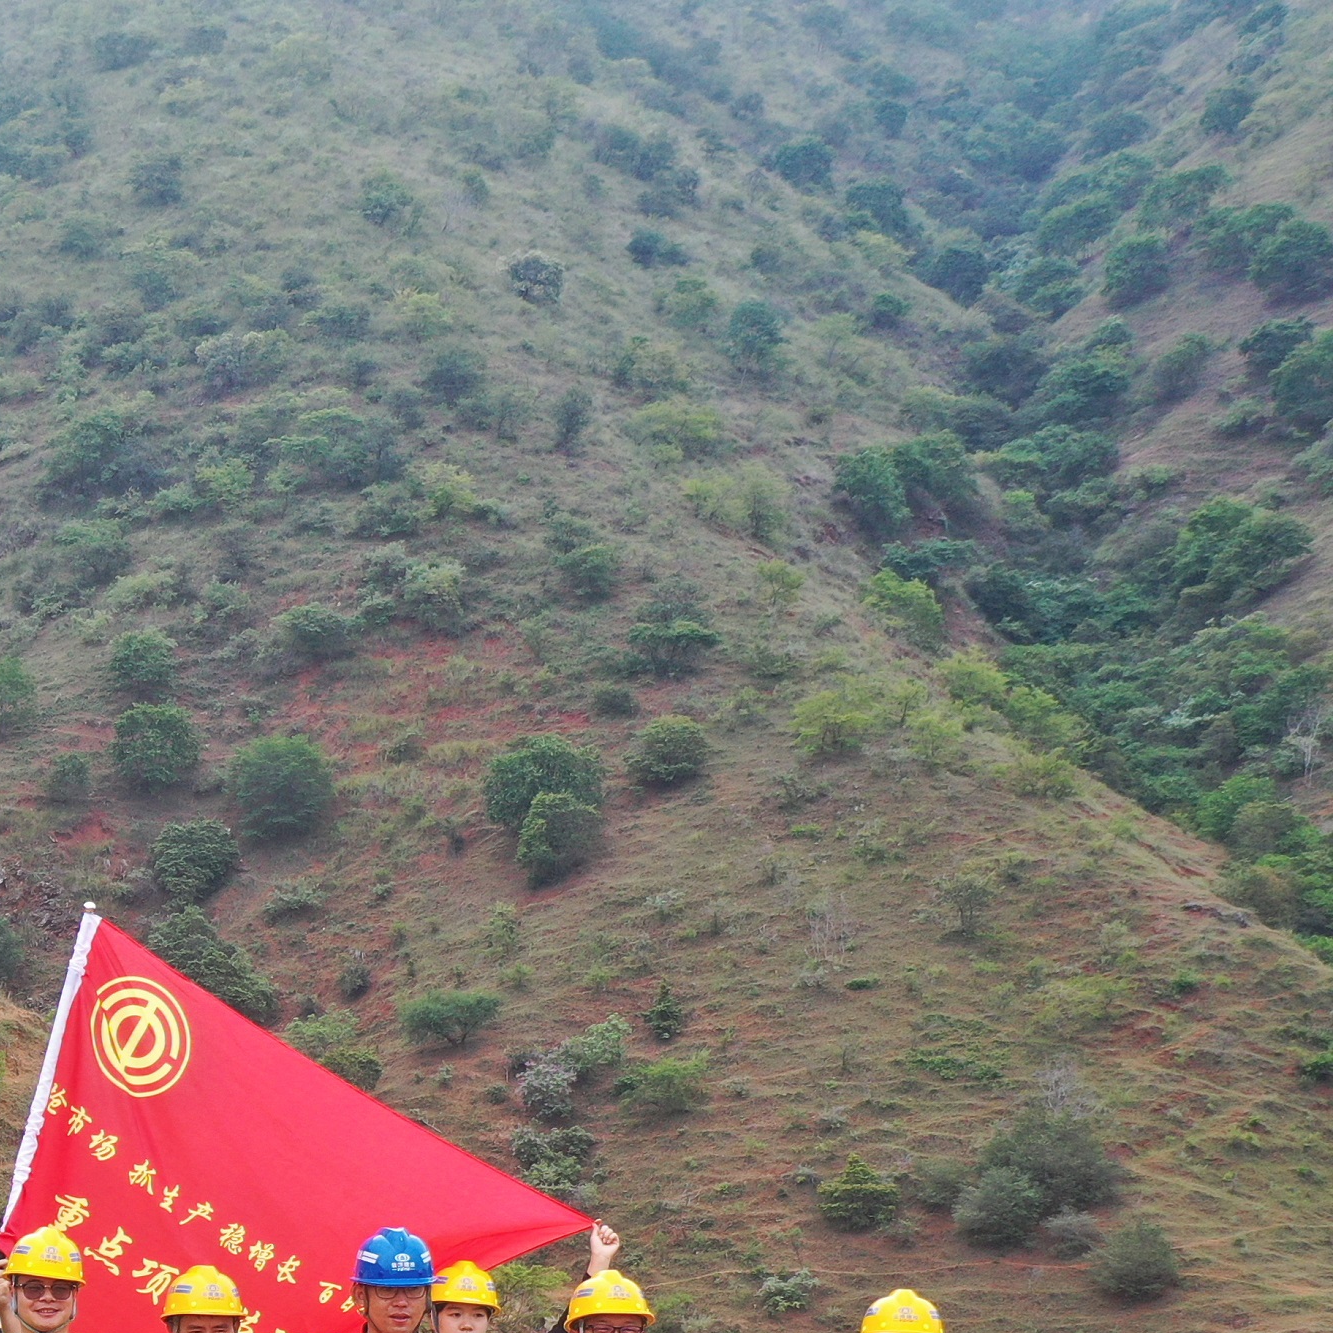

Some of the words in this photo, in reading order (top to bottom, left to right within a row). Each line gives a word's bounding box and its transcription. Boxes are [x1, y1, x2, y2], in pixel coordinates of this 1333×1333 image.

[128, 1158, 214, 1225] 抓生产
[218, 1222, 301, 1285] 稳增长
